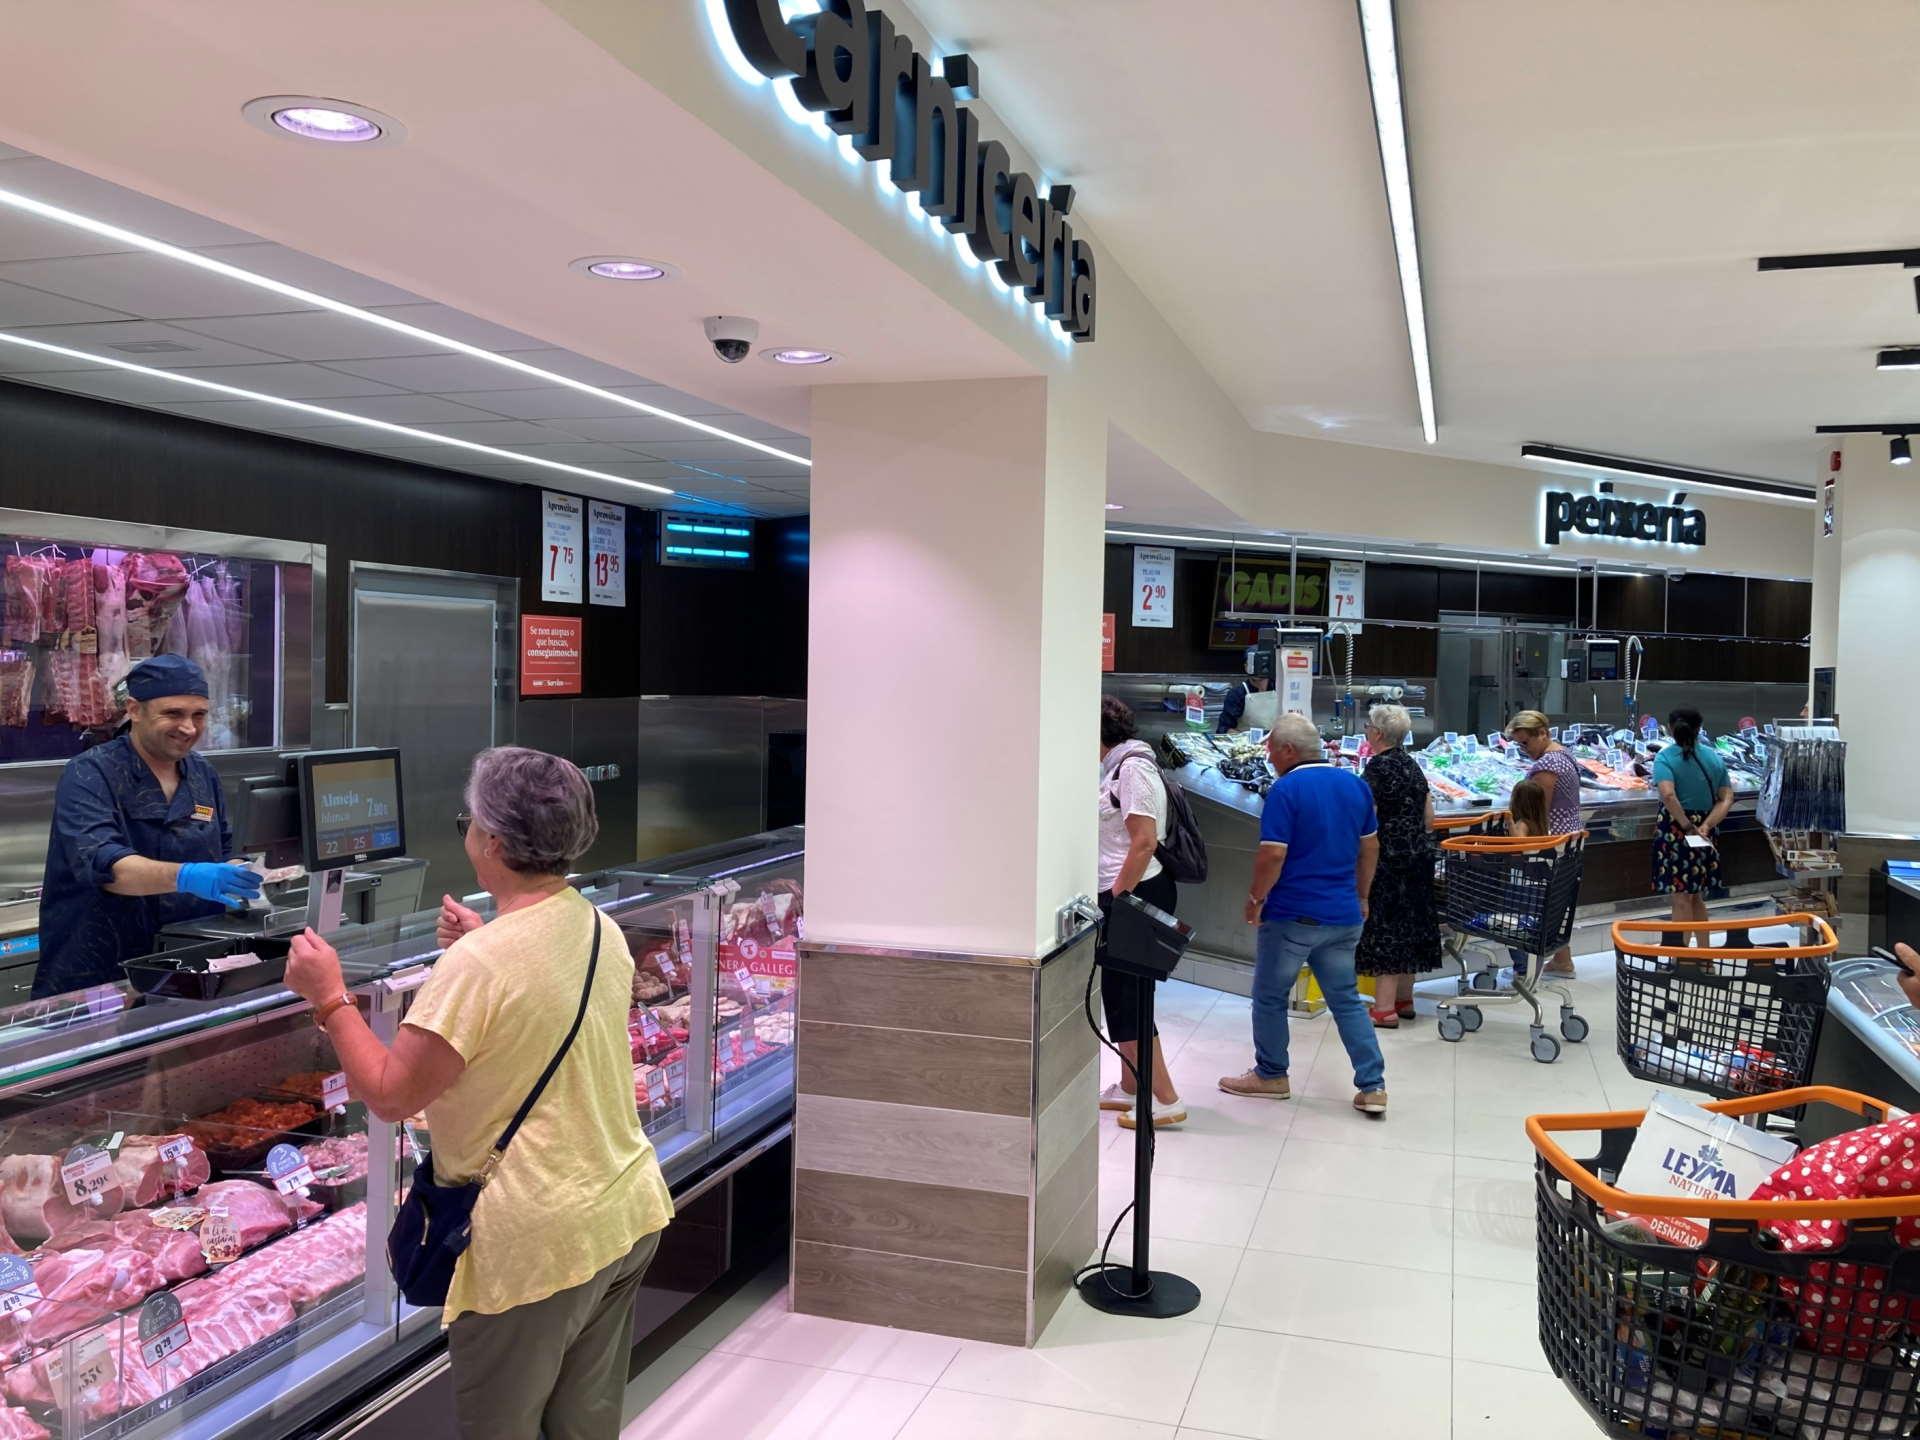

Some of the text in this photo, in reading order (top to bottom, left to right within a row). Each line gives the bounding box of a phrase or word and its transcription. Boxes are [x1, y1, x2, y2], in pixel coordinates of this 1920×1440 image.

[1545, 482, 1706, 545] peixería
[1225, 570, 1321, 607] GADIS
[326, 841, 338, 855] 22
[353, 836, 366, 850] 25
[719, 959, 795, 975] NERA GALLEG
[1662, 1147, 1736, 1200] LEYMA
